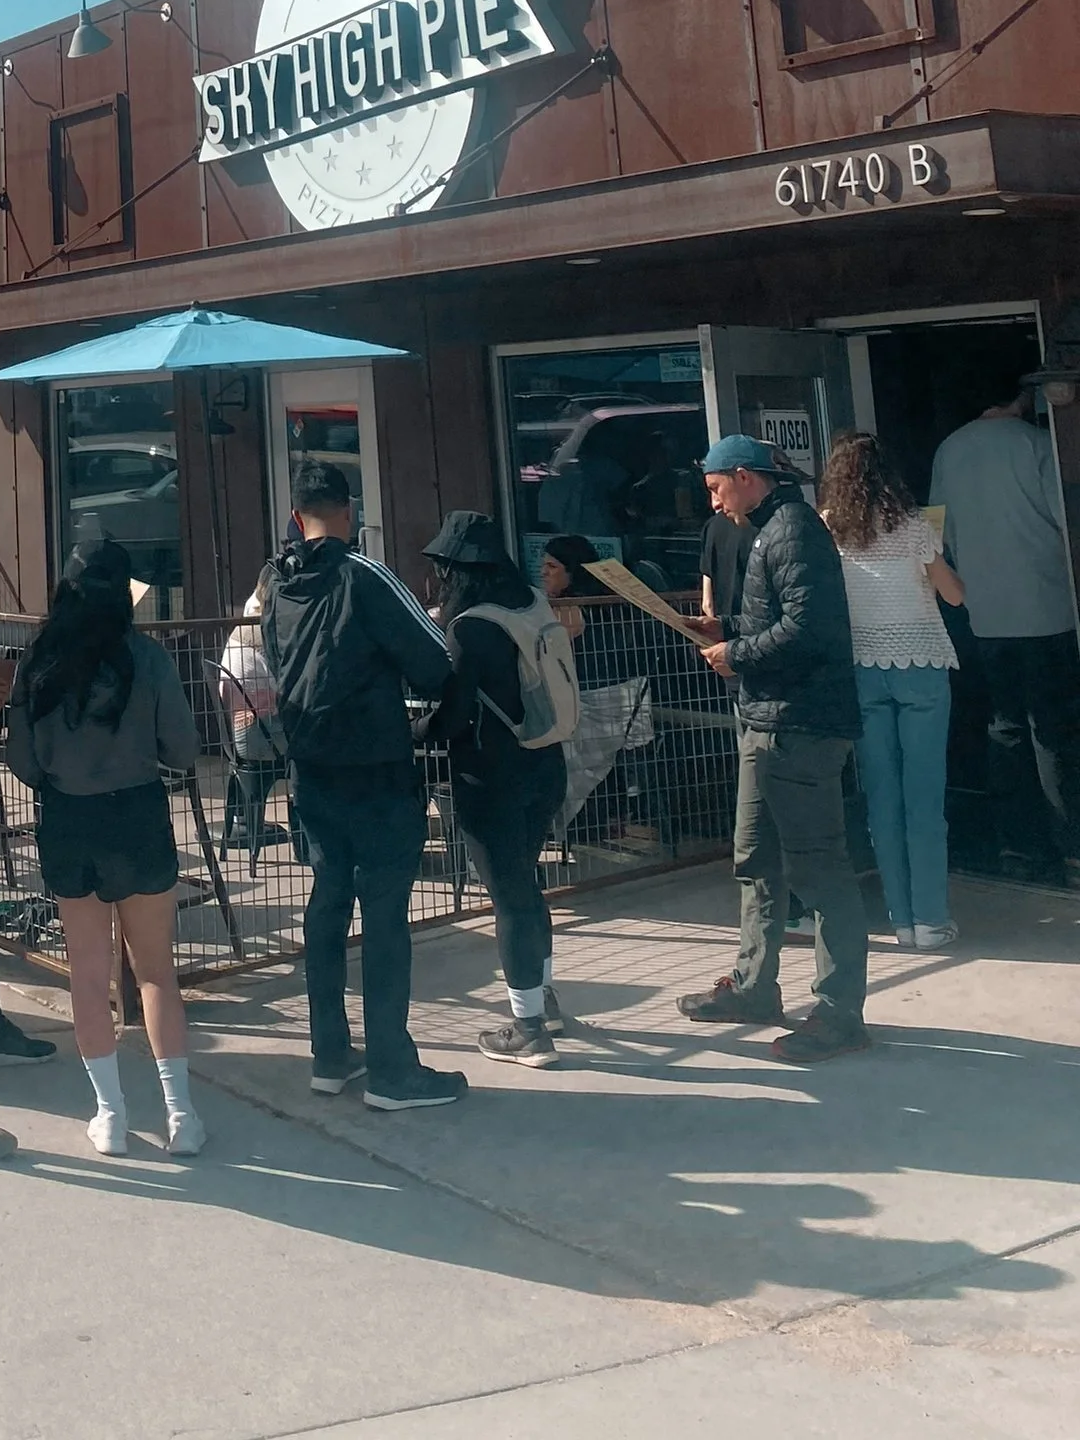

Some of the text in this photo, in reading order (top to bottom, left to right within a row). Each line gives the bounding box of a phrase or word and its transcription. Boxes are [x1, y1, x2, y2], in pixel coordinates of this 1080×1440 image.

[202, 53, 278, 145] SKY
[292, 0, 402, 118] HIGH
[775, 143, 933, 206] 61740 B
[765, 419, 809, 450] CLOSED
